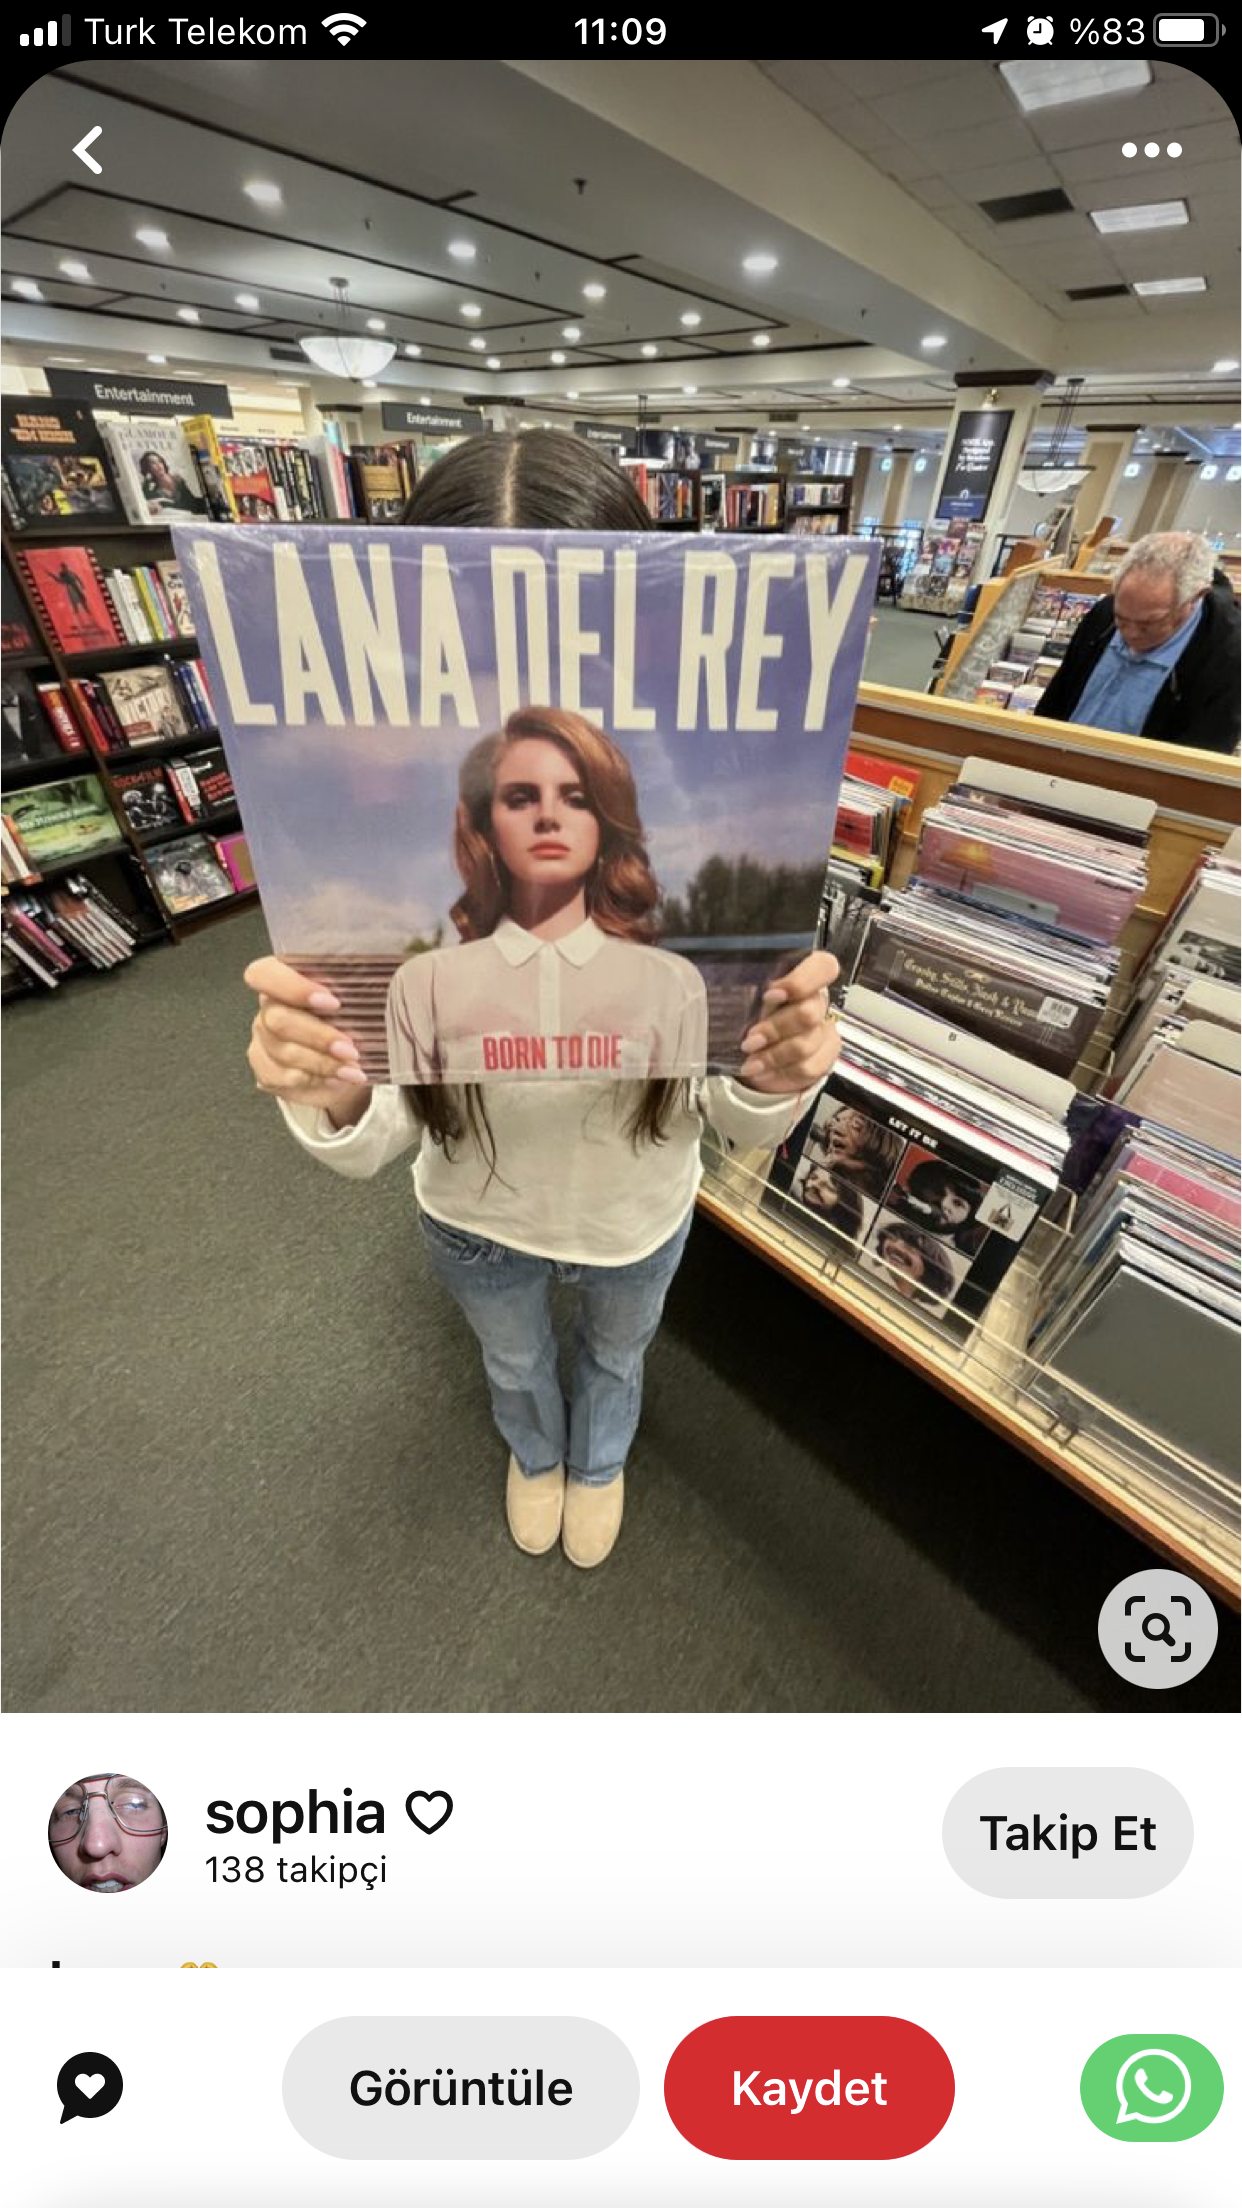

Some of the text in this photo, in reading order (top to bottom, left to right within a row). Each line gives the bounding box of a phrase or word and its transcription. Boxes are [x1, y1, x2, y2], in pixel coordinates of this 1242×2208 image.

[94, 383, 195, 407] Entertainment
[406, 411, 463, 429] Entertainment
[193, 541, 871, 732] LANA DEL REY
[483, 1034, 624, 1071] BORN TO DIE
[888, 1116, 939, 1149] LET IT BE
